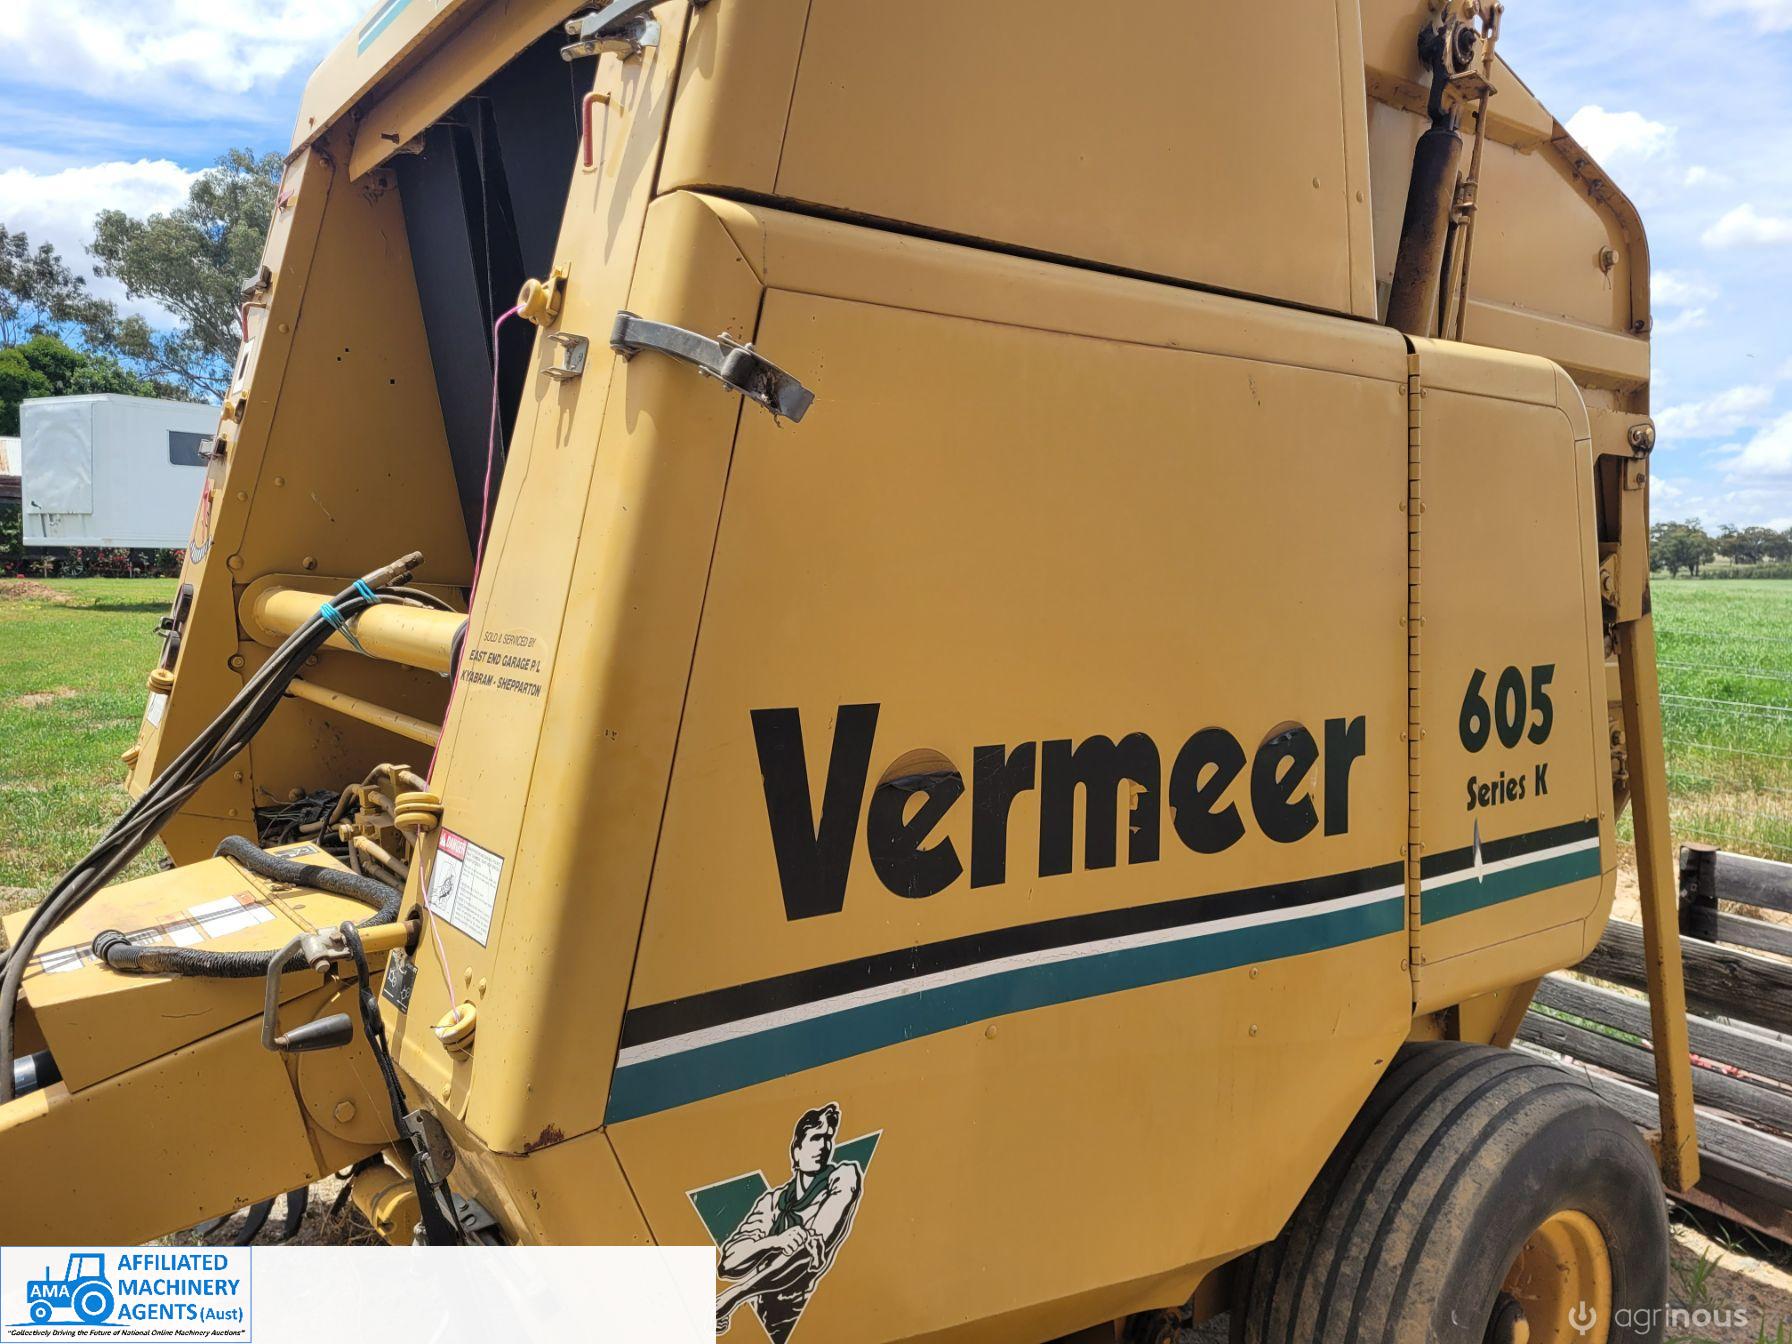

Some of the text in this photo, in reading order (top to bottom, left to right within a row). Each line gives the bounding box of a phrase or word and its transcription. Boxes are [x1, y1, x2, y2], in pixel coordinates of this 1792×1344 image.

[484, 631, 498, 643] SOLD
[503, 634, 528, 647] SERVICED
[528, 638, 536, 647] BY
[469, 649, 487, 662] EAST
[487, 653, 501, 666] END
[502, 654, 530, 671] GARAGE
[461, 670, 493, 687] KYABRAM
[497, 676, 542, 697] SHEPPARTON
[1459, 664, 1556, 753] 605
[1466, 763, 1548, 811] Series K
[750, 702, 1366, 922] Vermeer
